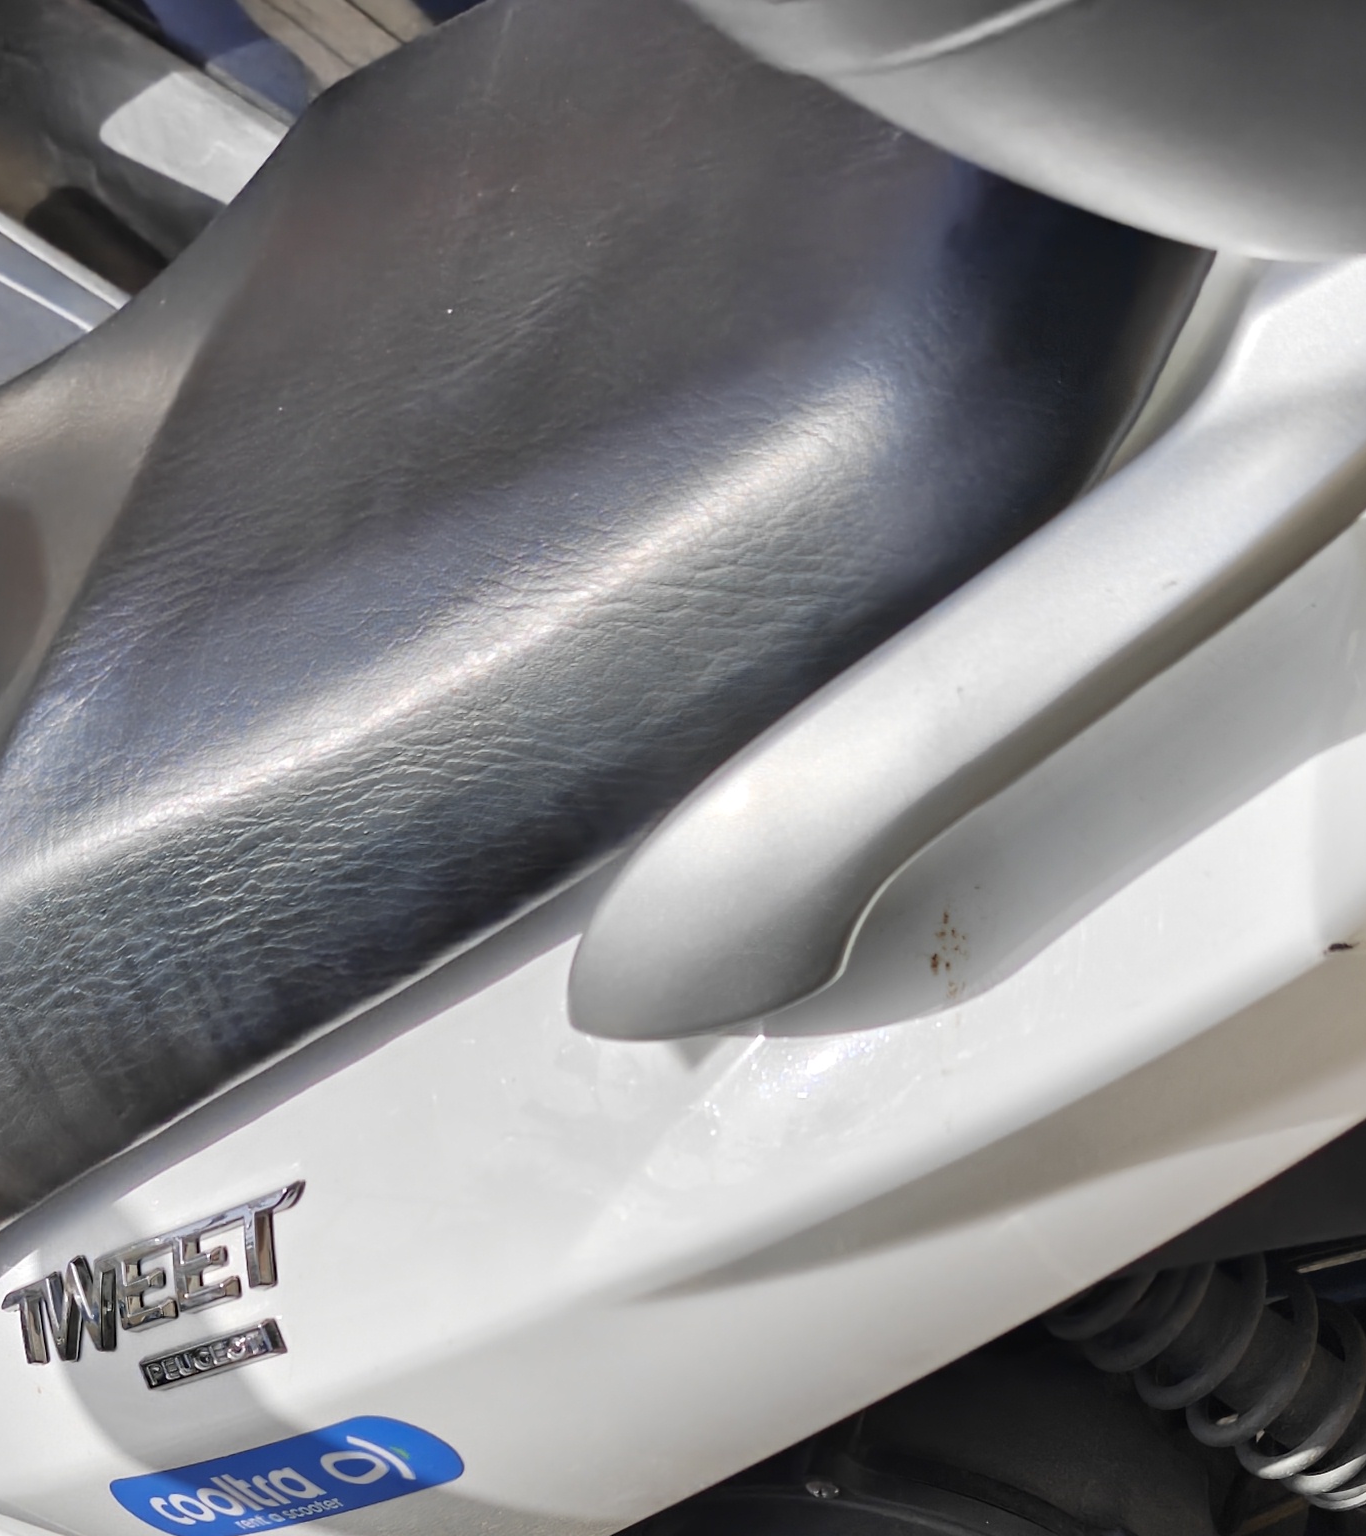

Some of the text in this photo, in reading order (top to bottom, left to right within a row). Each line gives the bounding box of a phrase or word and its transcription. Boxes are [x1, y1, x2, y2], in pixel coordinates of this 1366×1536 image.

[1, 1180, 306, 1366] TWEET
[147, 1328, 275, 1386] PEUGEOT
[149, 1466, 326, 1525] cooltra
[235, 1514, 271, 1530] rent
[284, 1497, 344, 1520] scooter
